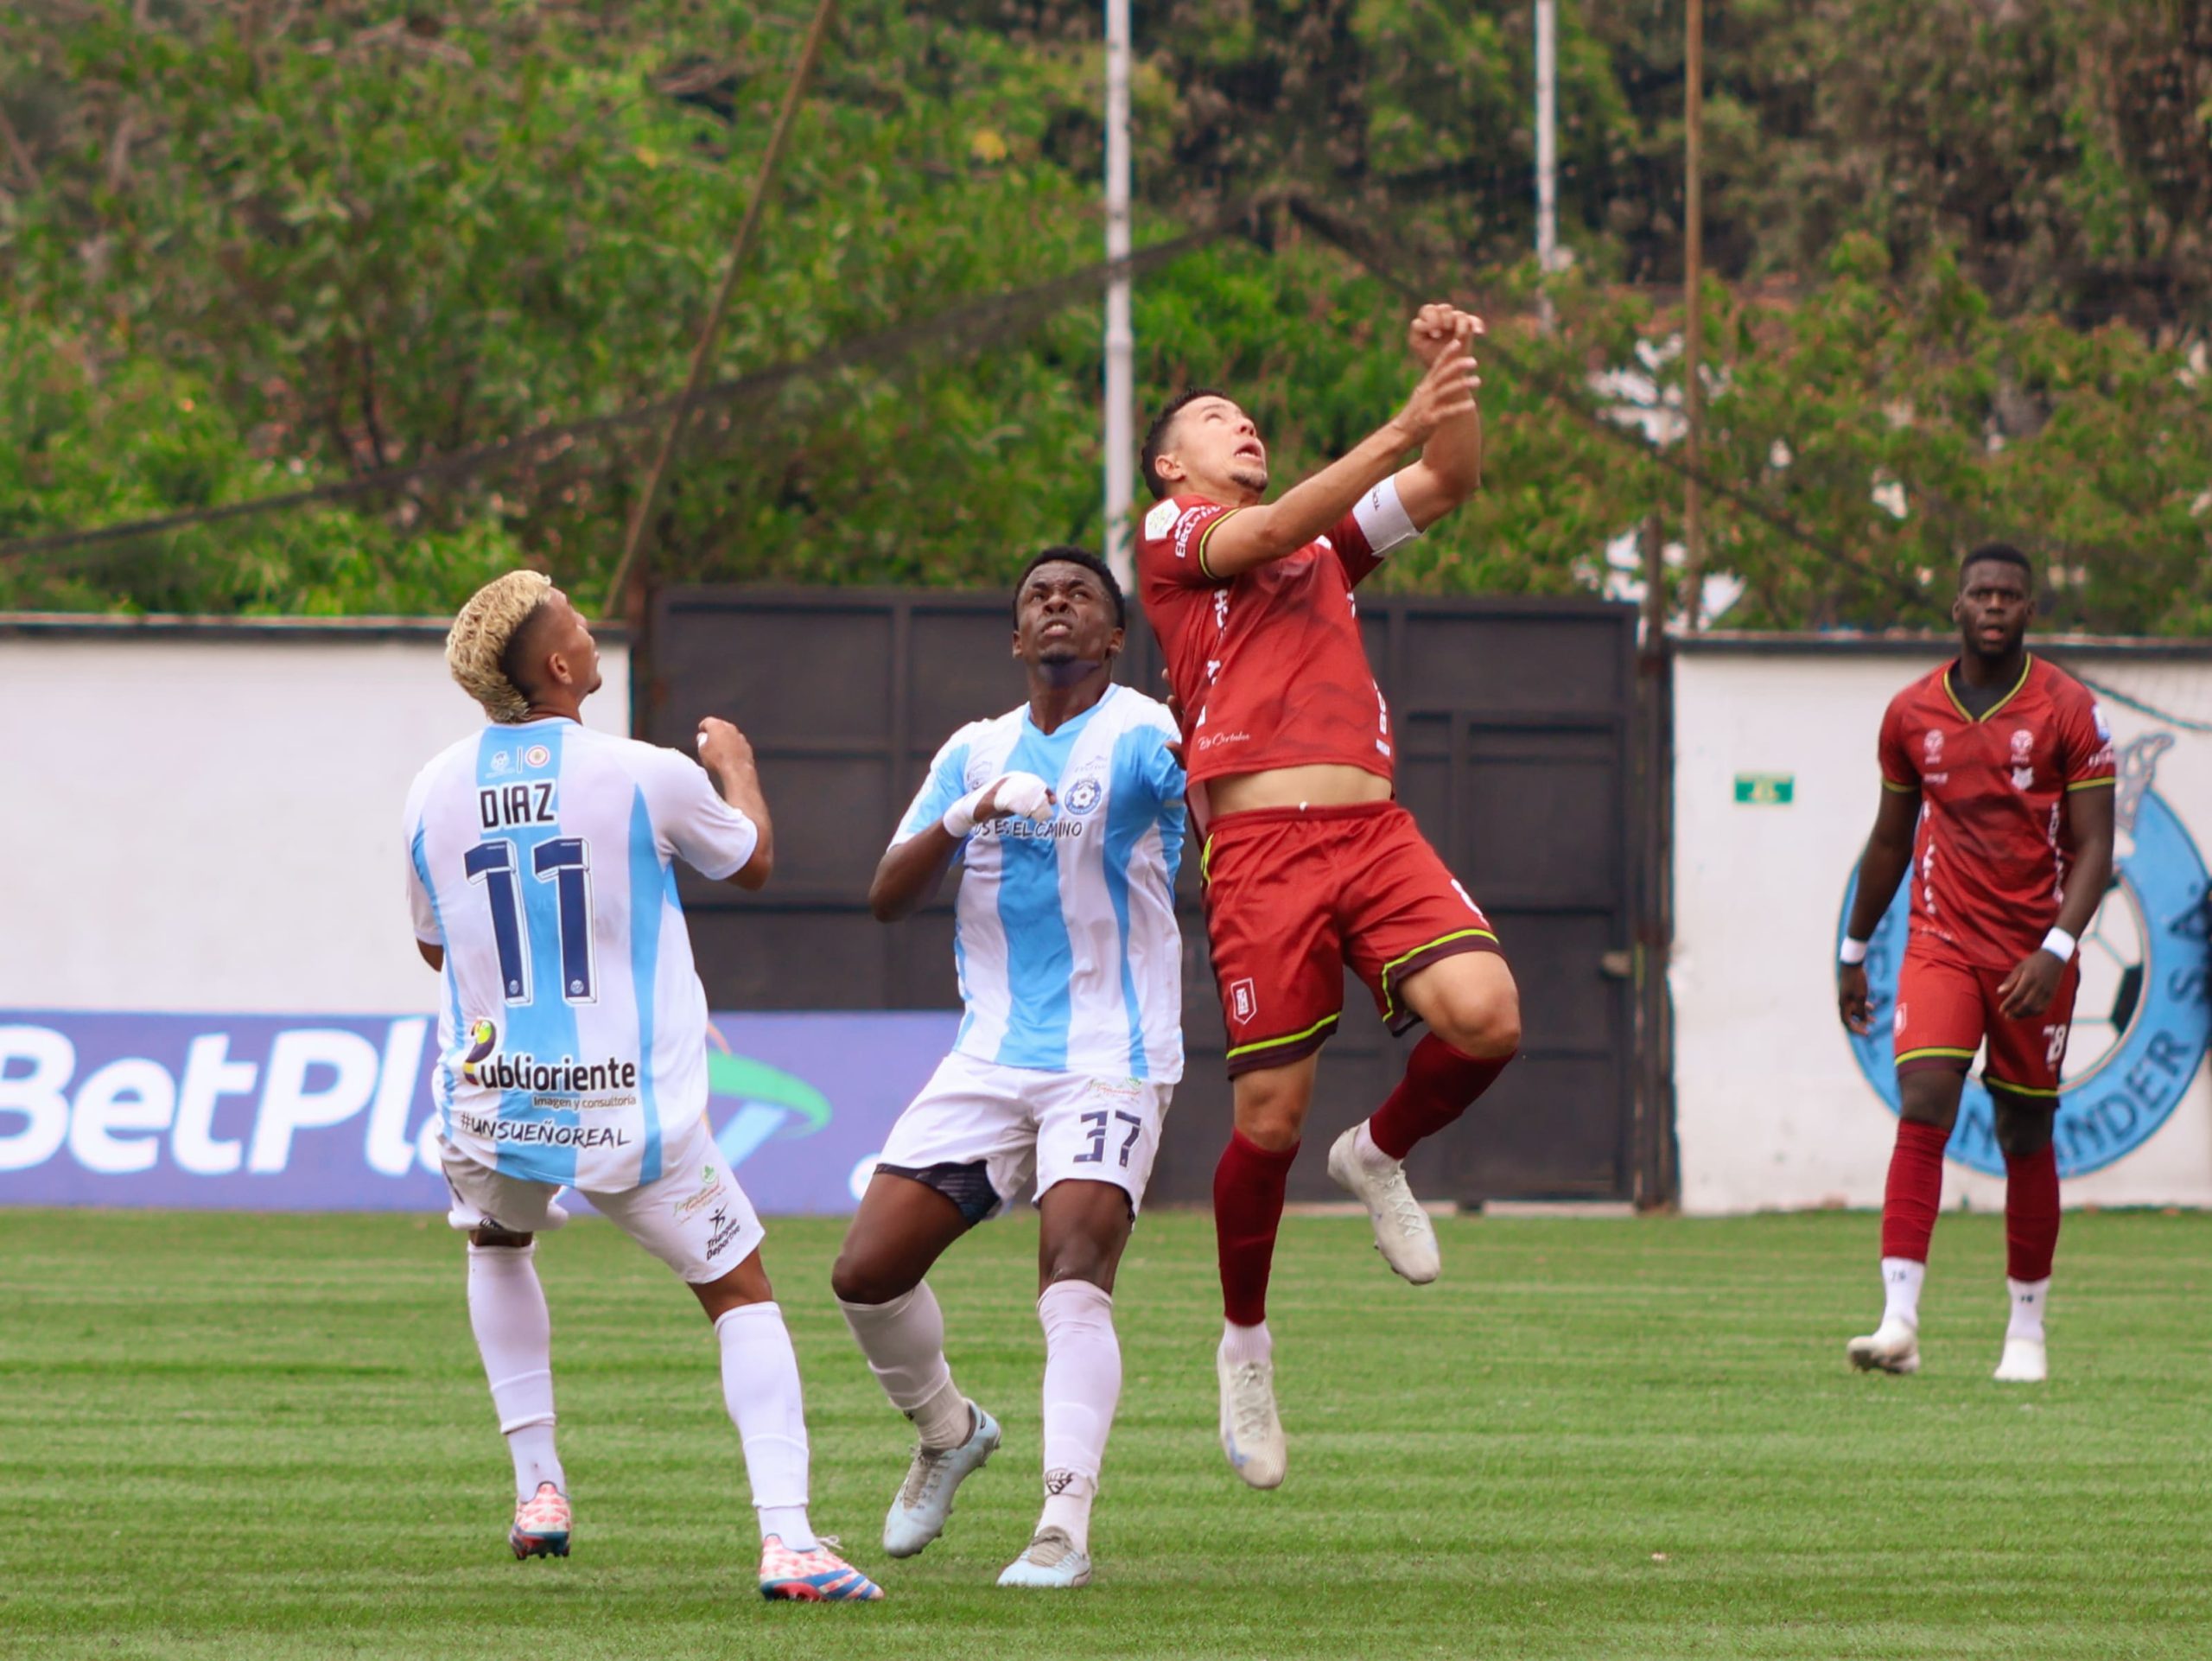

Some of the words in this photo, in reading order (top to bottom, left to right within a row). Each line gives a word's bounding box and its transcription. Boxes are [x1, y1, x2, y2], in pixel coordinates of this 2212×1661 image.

[480, 782, 555, 829] DIAZ
[1013, 822, 1034, 837] EL
[464, 839, 597, 1006] 11
[533, 1096, 571, 1109] Imagen
[573, 1099, 581, 1111] y
[461, 1112, 632, 1149] #UNSUEÑOREAL
[1073, 1110, 1141, 1168] 37
